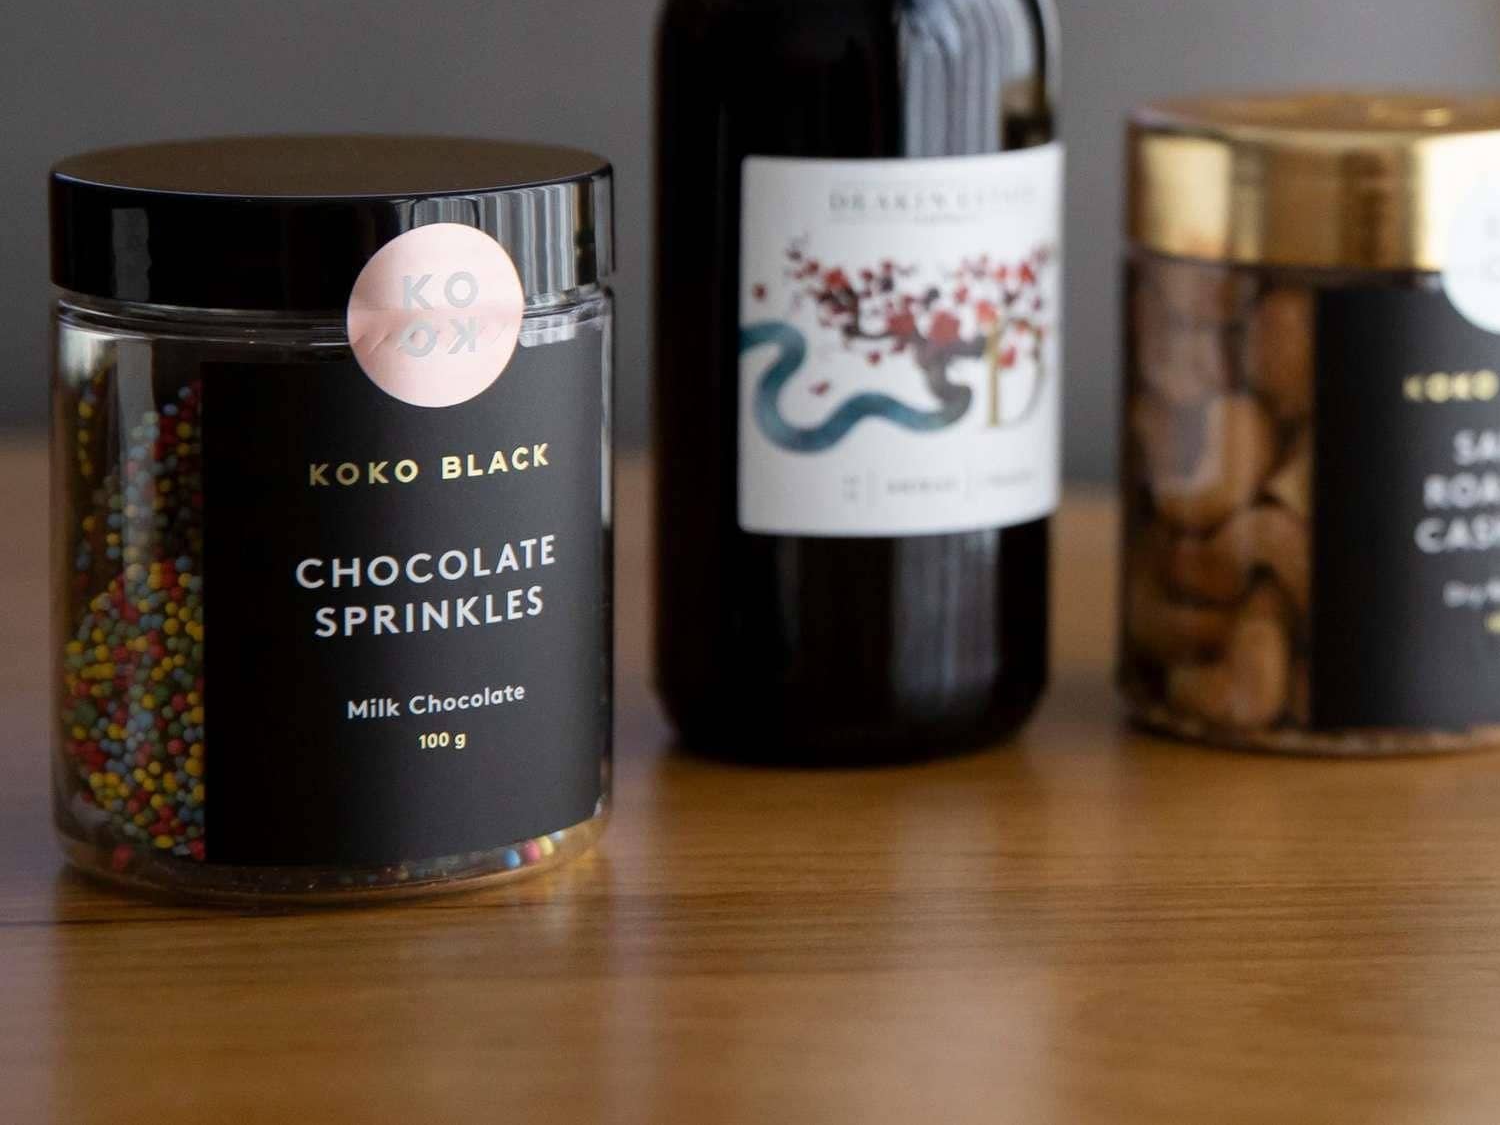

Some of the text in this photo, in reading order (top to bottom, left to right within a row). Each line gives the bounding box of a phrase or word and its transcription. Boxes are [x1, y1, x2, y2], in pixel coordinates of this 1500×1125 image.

[402, 271, 479, 311] KO
[1403, 370, 1499, 403] KOKO
[308, 442, 550, 486] KOKO BLACK
[295, 534, 556, 589] CHOCOLATE
[314, 585, 544, 638] SPRINKLES
[347, 684, 526, 720] Milk Chocolate
[417, 731, 468, 750] 100 g
